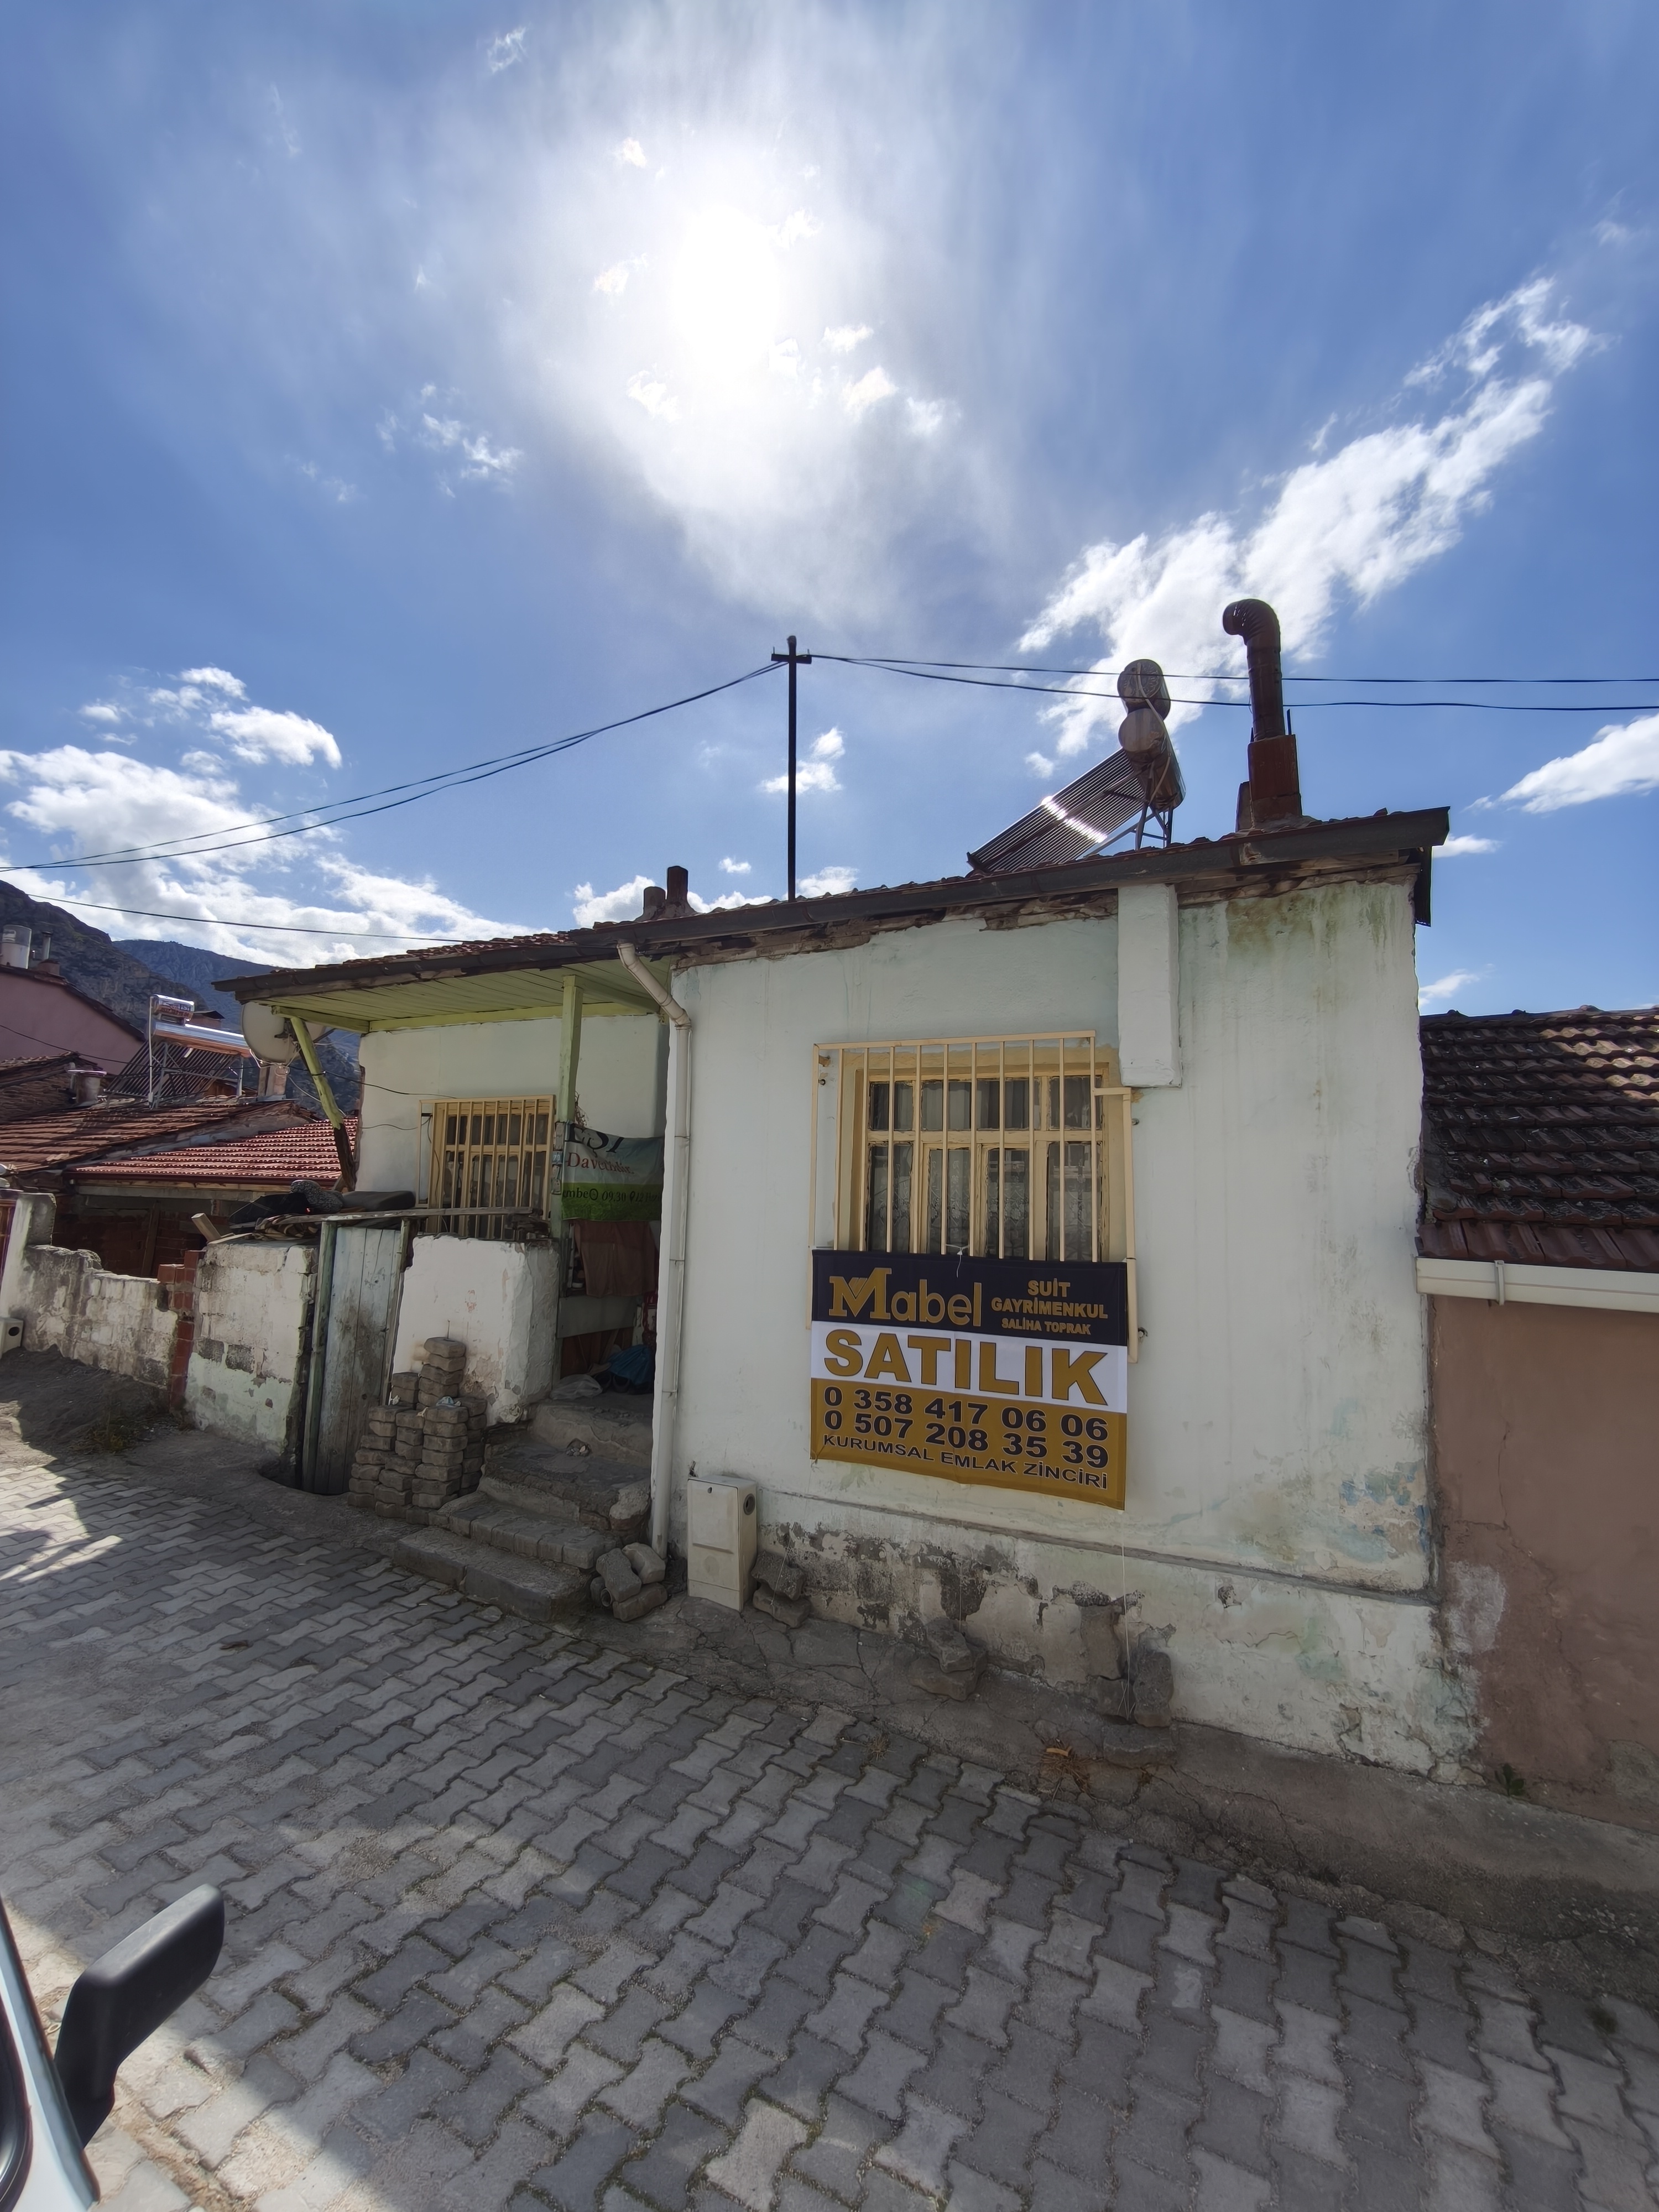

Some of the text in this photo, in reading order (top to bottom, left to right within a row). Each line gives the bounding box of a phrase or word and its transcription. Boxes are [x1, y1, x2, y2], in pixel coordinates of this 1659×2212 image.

[602, 1191, 626, 1202] 09.30
[829, 1267, 982, 1327] Mabel
[991, 1297, 1108, 1319] GAYRİMENKUL
[1027, 1278, 1071, 1298] SUİT
[1001, 1317, 1091, 1335] SALİHA TOPRAK
[824, 1329, 1108, 1406] SATILIK
[824, 1386, 1109, 1441] 0 358 417 06 06
[824, 1410, 1109, 1469] 0 507 208 35 39
[823, 1434, 1108, 1489] KURUMSAL EMLAK ZİNCİRİ
